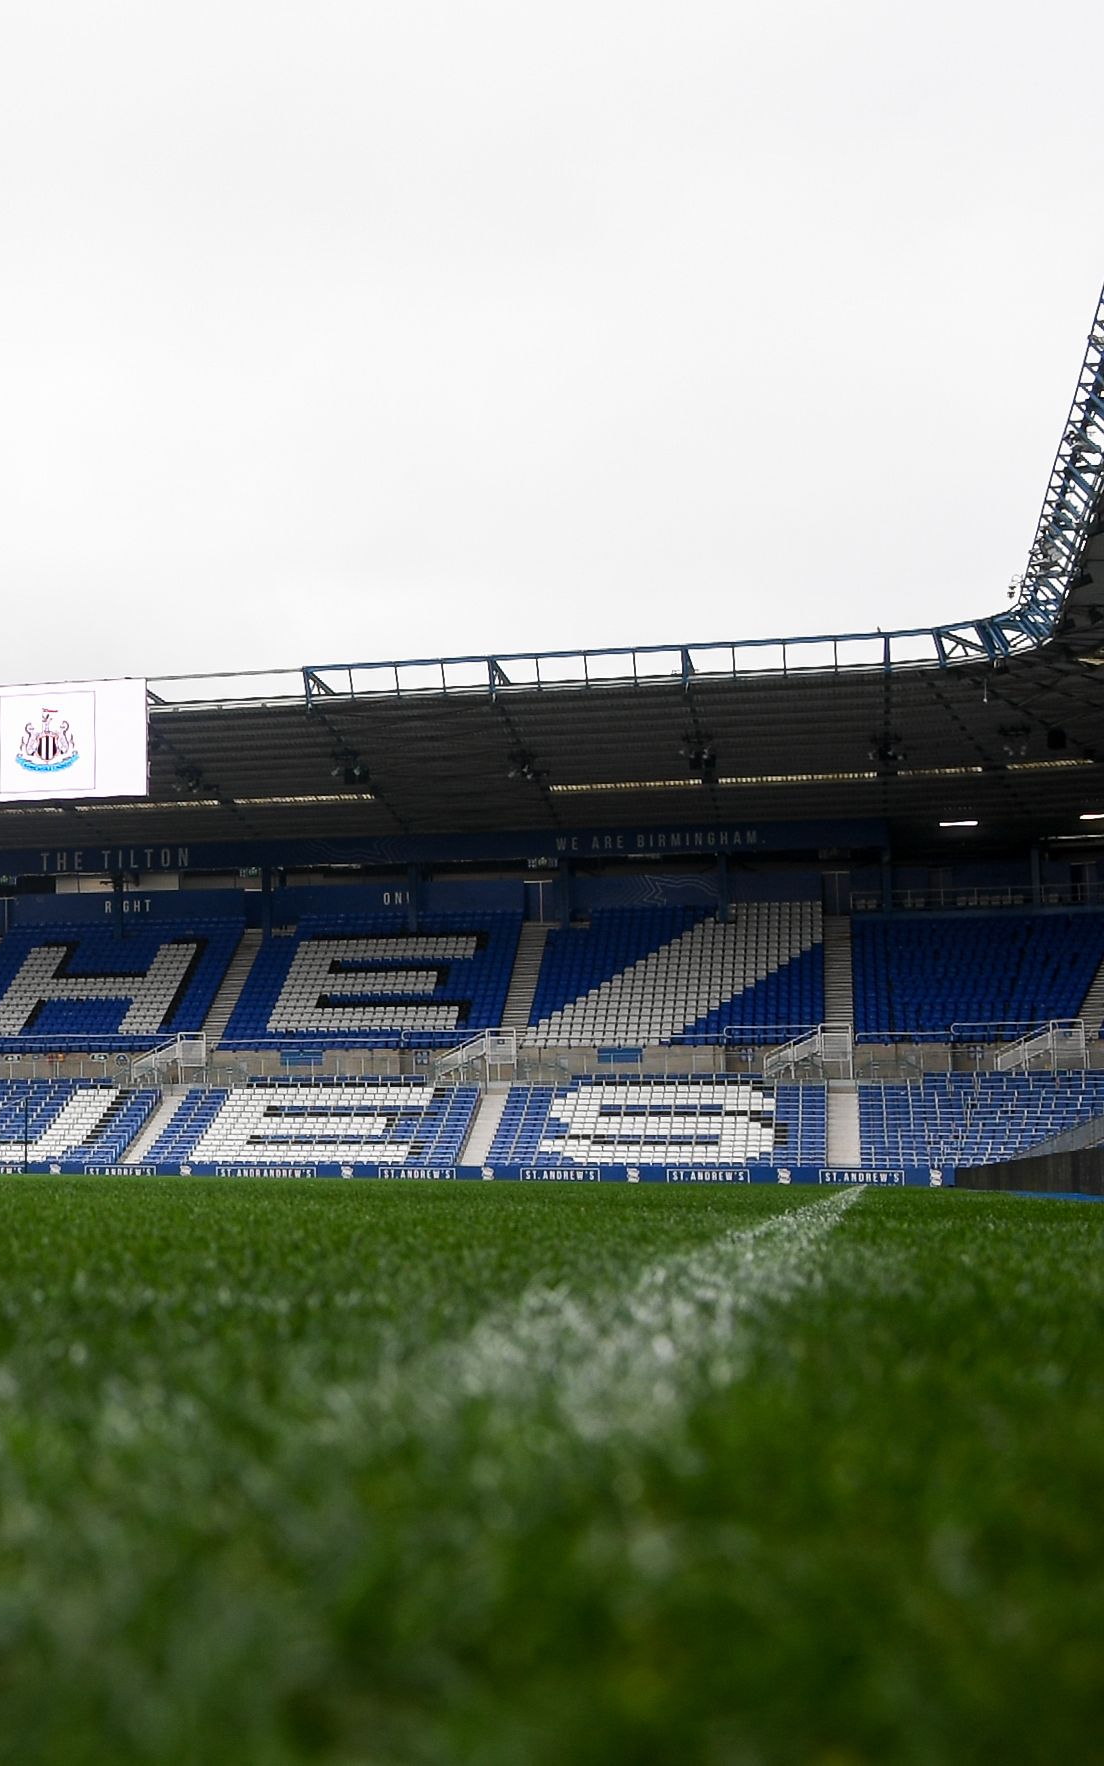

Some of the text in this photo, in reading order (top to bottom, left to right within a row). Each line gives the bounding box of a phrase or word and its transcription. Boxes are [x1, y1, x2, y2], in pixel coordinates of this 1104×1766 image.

[556, 836, 579, 851] WE
[591, 835, 624, 849] ARE
[40, 848, 189, 871] THE TILTON
[104, 899, 152, 914] RGHT
